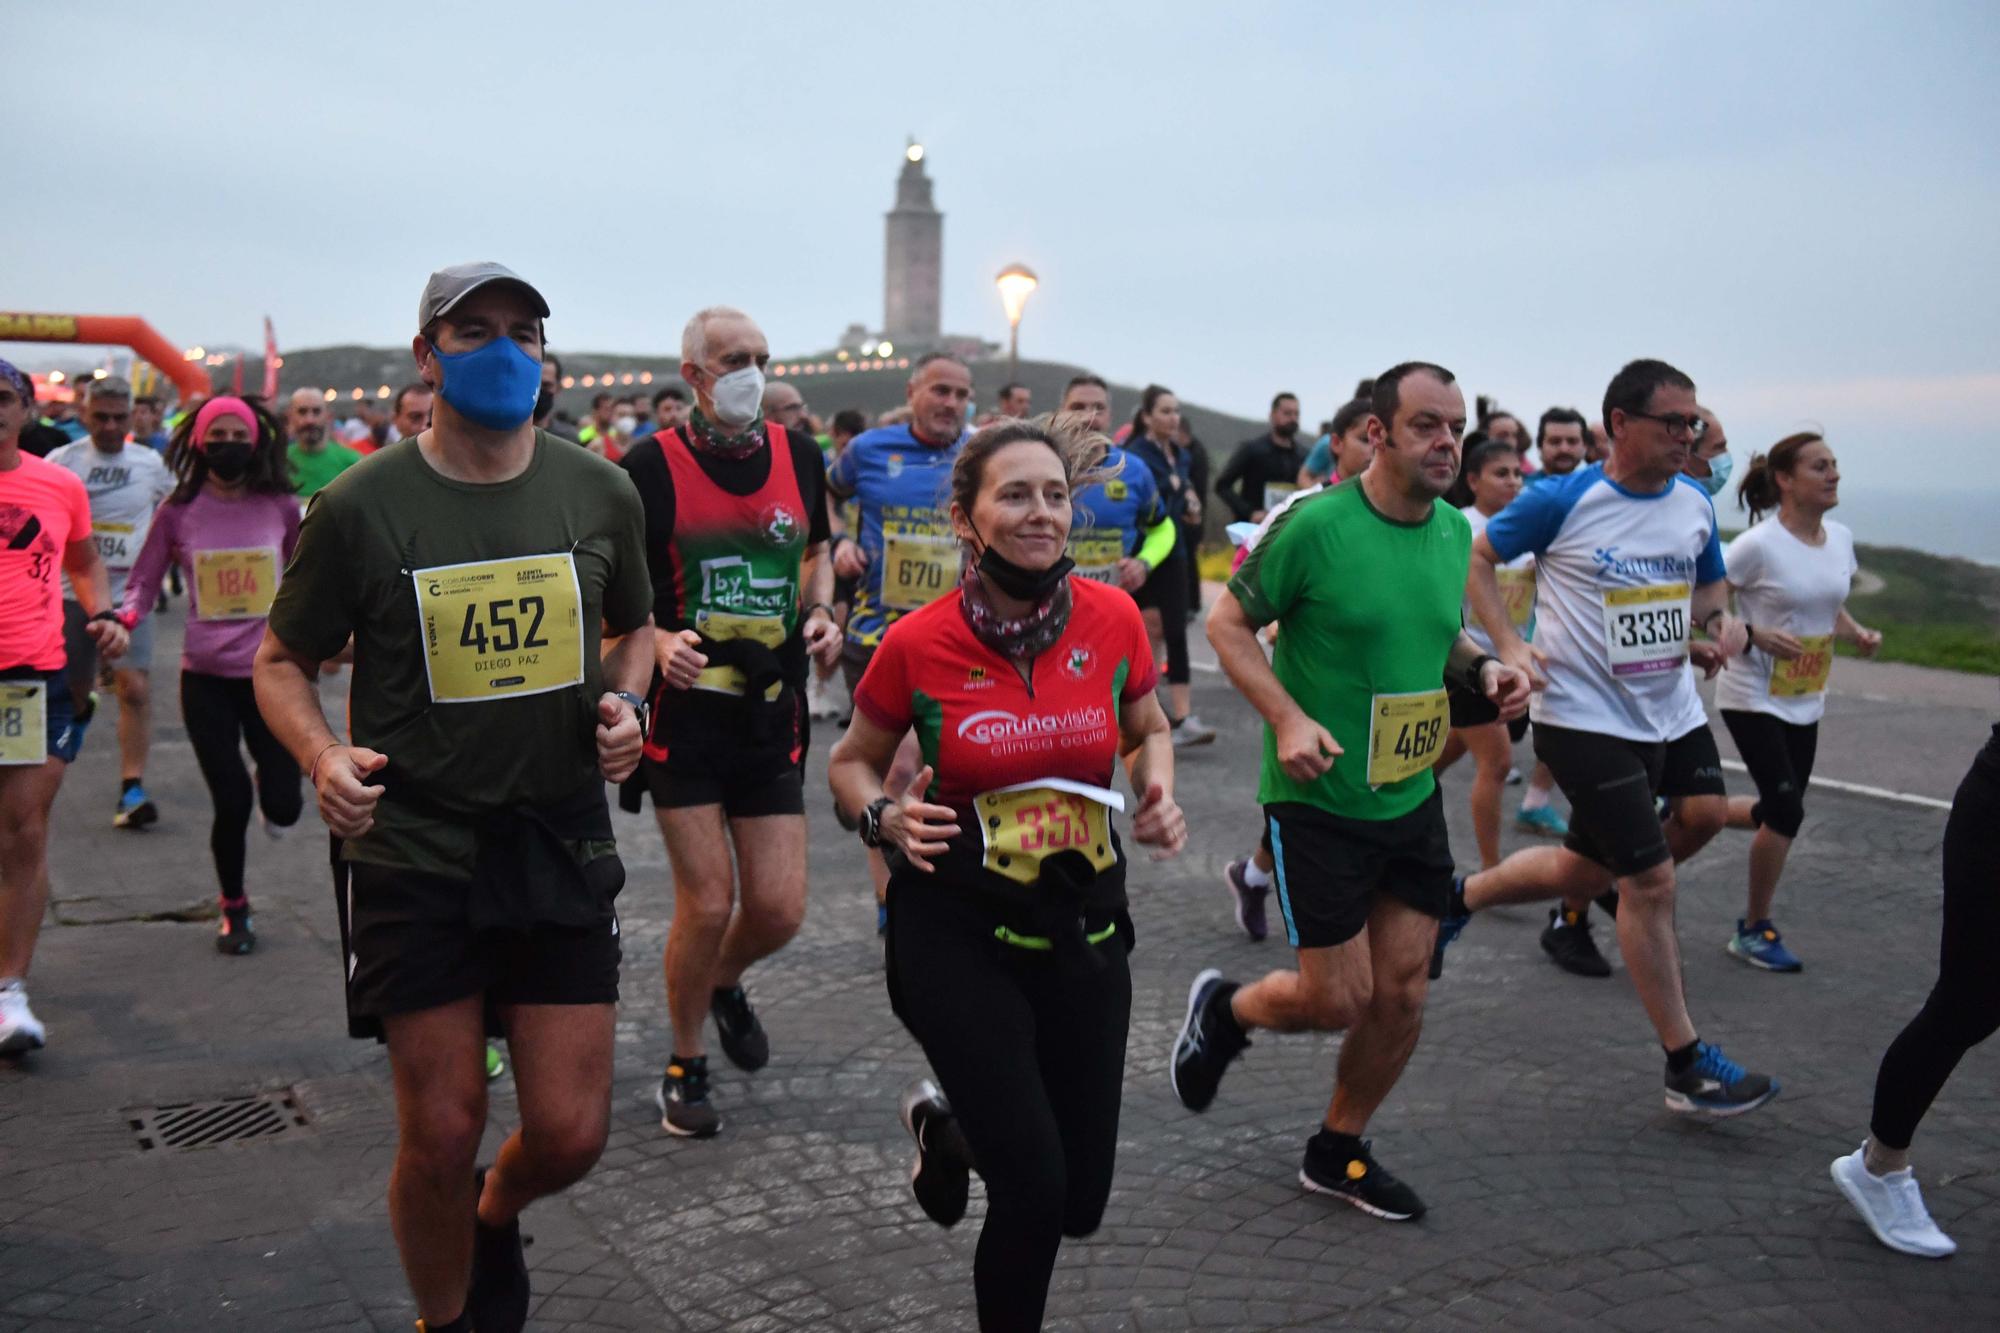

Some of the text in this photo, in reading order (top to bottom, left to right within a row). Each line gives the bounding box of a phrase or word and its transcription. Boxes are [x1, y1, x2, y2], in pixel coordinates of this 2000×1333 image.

[88, 466, 131, 486] RUN
[217, 568, 257, 597] 184
[715, 573, 742, 594] by
[898, 560, 942, 588] 670
[427, 615, 438, 649] TANDA
[459, 596, 549, 655] 452
[1618, 608, 1684, 648] 3330
[475, 654, 540, 672] DIEGO PAZ
[974, 704, 1107, 738] coruñavisión
[1060, 728, 1108, 749] ocular
[1394, 716, 1442, 761] 468
[1016, 797, 1090, 851] 353
